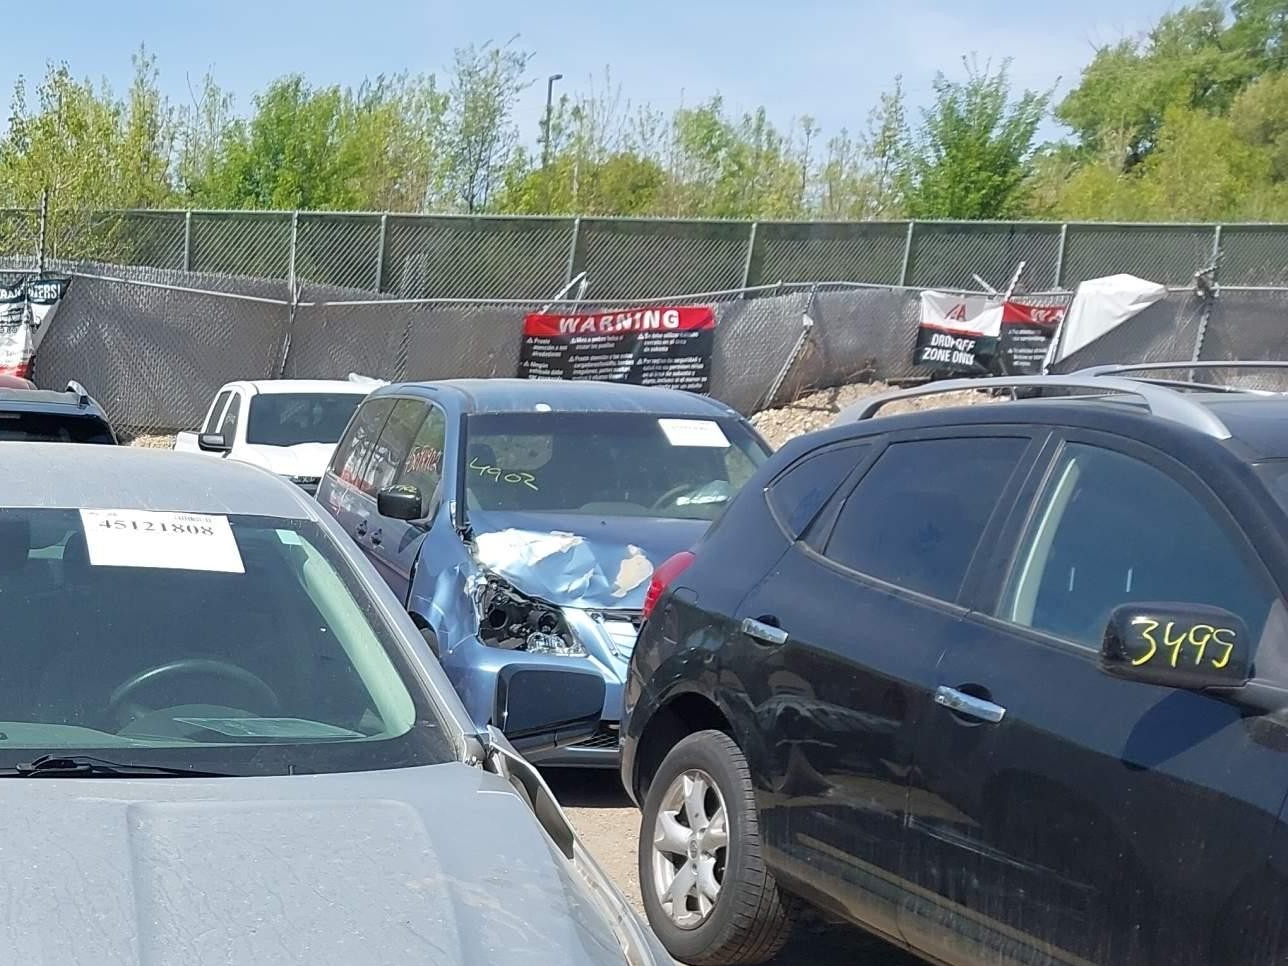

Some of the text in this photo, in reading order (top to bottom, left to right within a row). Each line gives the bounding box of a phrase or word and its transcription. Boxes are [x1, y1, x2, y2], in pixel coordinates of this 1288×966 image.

[559, 309, 680, 334] WARNING
[922, 347, 975, 366] ZONE ONLY
[469, 456, 539, 491] 4902
[99, 519, 214, 536] 45121808
